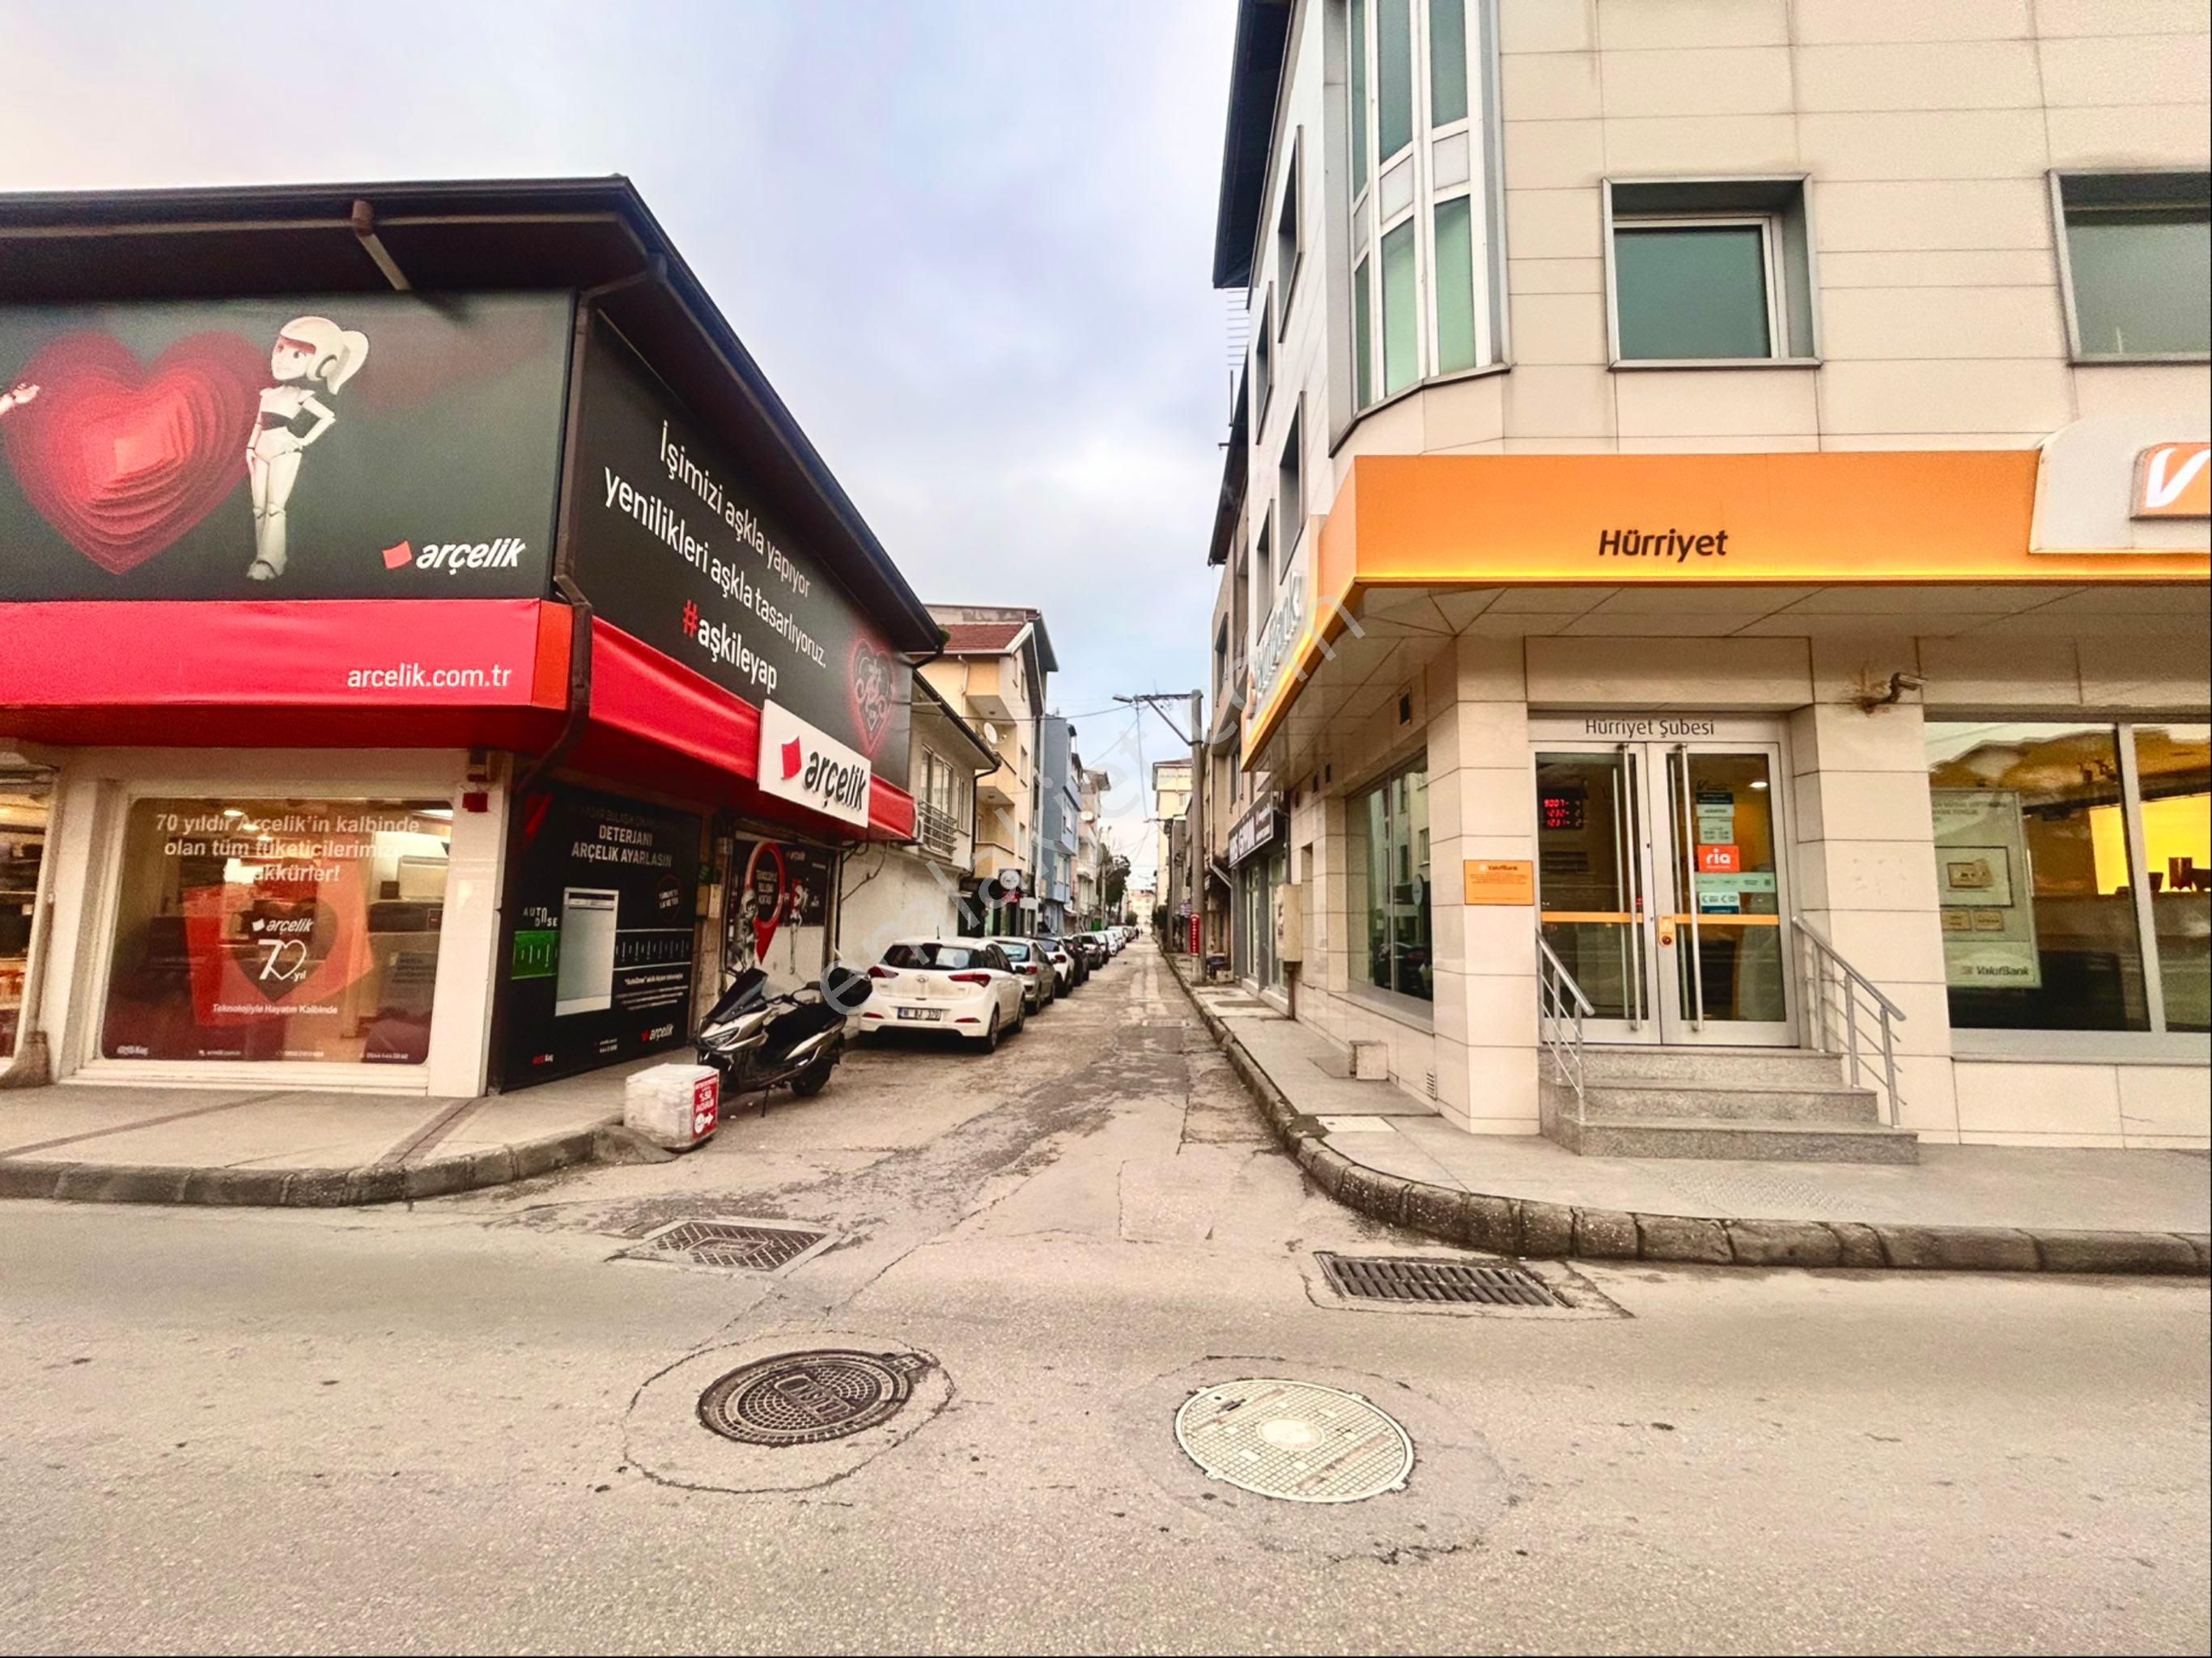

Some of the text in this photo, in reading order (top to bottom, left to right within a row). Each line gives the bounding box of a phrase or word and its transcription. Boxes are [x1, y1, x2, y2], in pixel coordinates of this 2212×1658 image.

[660, 419, 810, 598] İşimizi aşkla yapıyor
[416, 538, 526, 575] arçelik
[1598, 528, 1729, 563] Hürriyet
[605, 466, 826, 669] yenilikleri aşkla tasarlıyoruz.
[682, 599, 778, 694] #aşkileyap
[347, 663, 512, 688] arcelik.com.tr
[1586, 719, 1714, 739] Hürriyet Şubesi
[805, 750, 867, 810] arçelik
[156, 814, 177, 832] 70
[183, 813, 233, 835] yıldır
[337, 816, 420, 833] kalbinde
[599, 825, 652, 846] DETERJANI
[164, 839, 206, 856] olan
[211, 840, 249, 856] tüm
[571, 842, 673, 867] ARÇELİK AYARLASIN
[1706, 848, 1731, 864] ria
[266, 918, 314, 935] arçelik
[648, 1023, 674, 1041] arçelik
